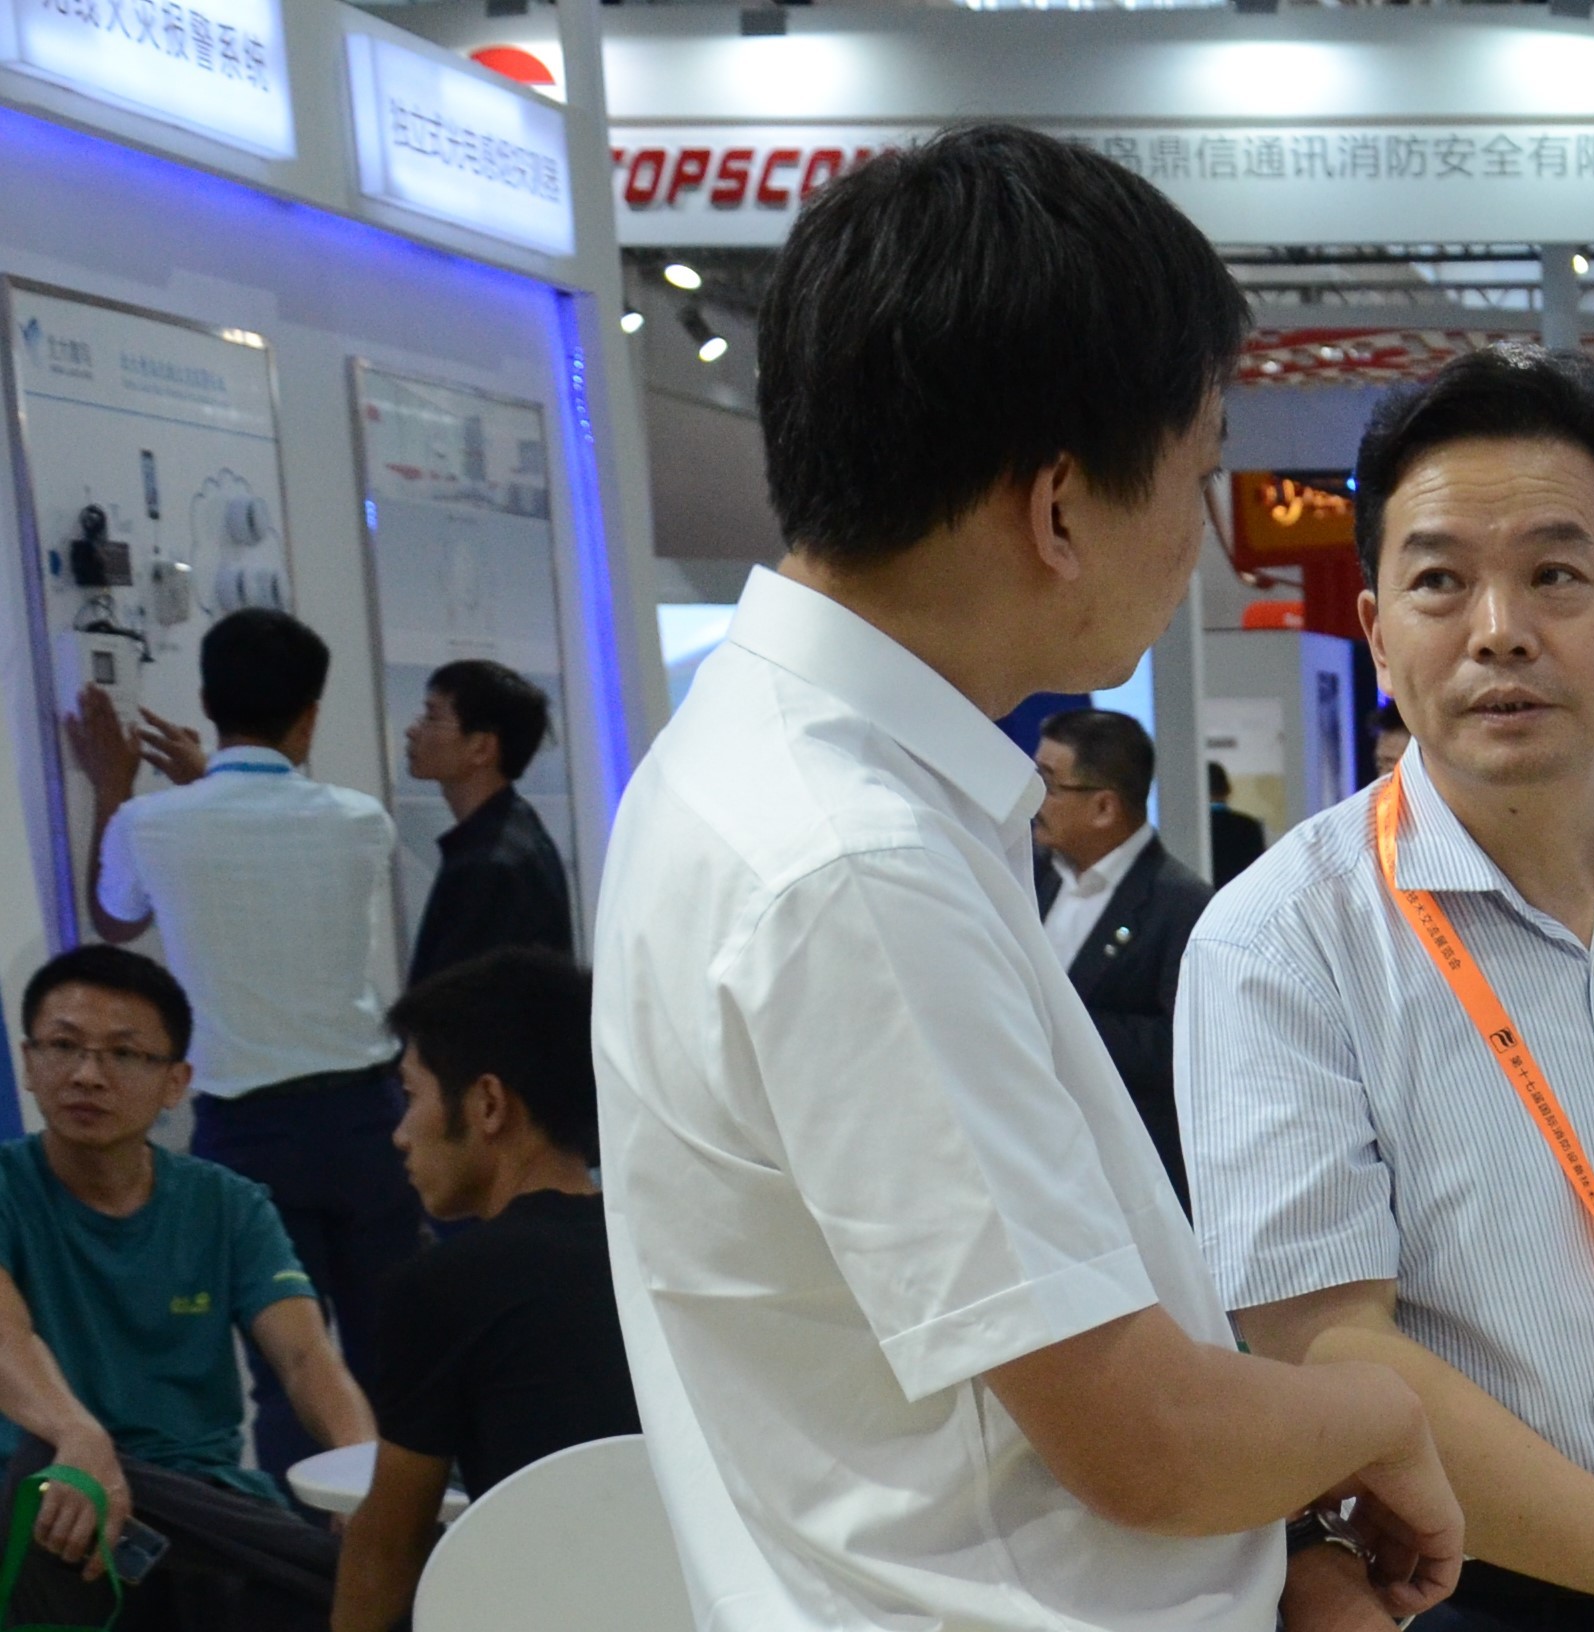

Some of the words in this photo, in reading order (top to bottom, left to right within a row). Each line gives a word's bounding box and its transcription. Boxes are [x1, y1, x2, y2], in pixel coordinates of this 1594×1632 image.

[1402, 888, 1462, 971] 技术交流展览会
